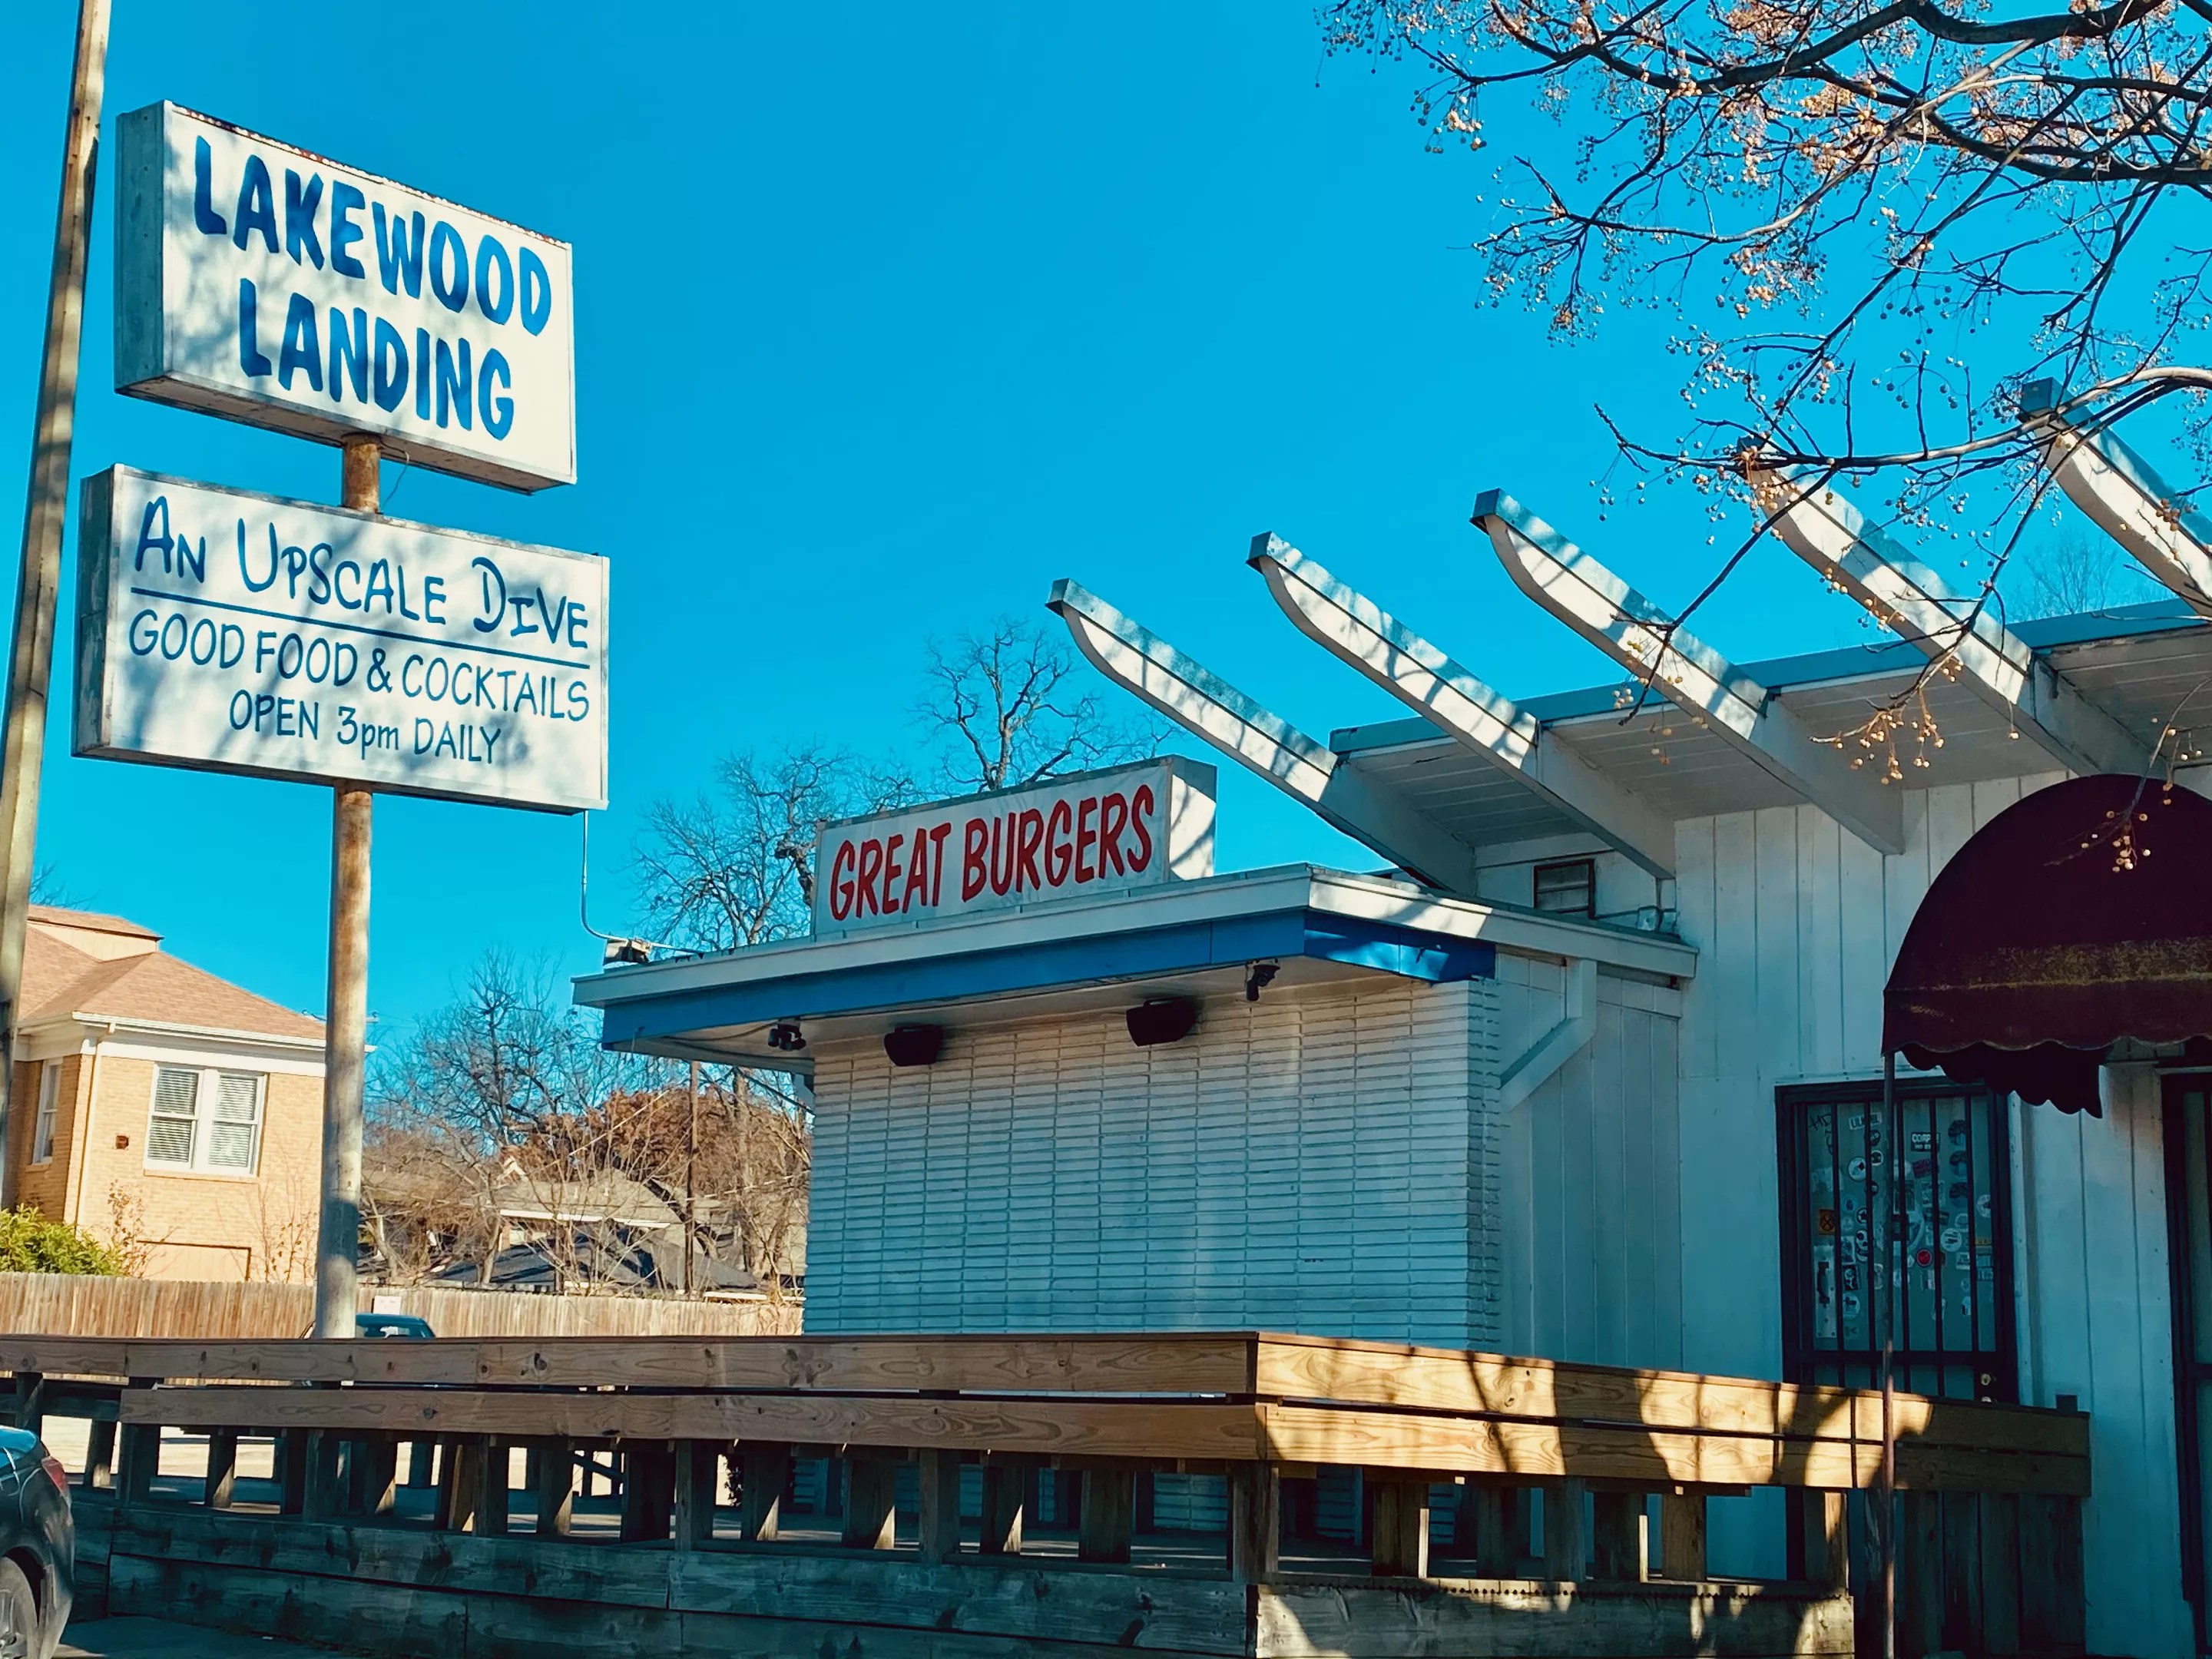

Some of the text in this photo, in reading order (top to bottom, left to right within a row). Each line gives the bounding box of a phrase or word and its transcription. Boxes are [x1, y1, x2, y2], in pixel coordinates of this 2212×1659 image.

[194, 135, 551, 336] LAKEWOOD
[239, 278, 515, 440] LANDING
[237, 518, 445, 624] UPSCALE
[472, 557, 588, 649] DIVE
[129, 609, 590, 721] GOOD FOOD & COCKTAILS
[230, 690, 502, 763] OPEN 3pm DAILY
[830, 784, 1154, 922] GREAT BURGERS
